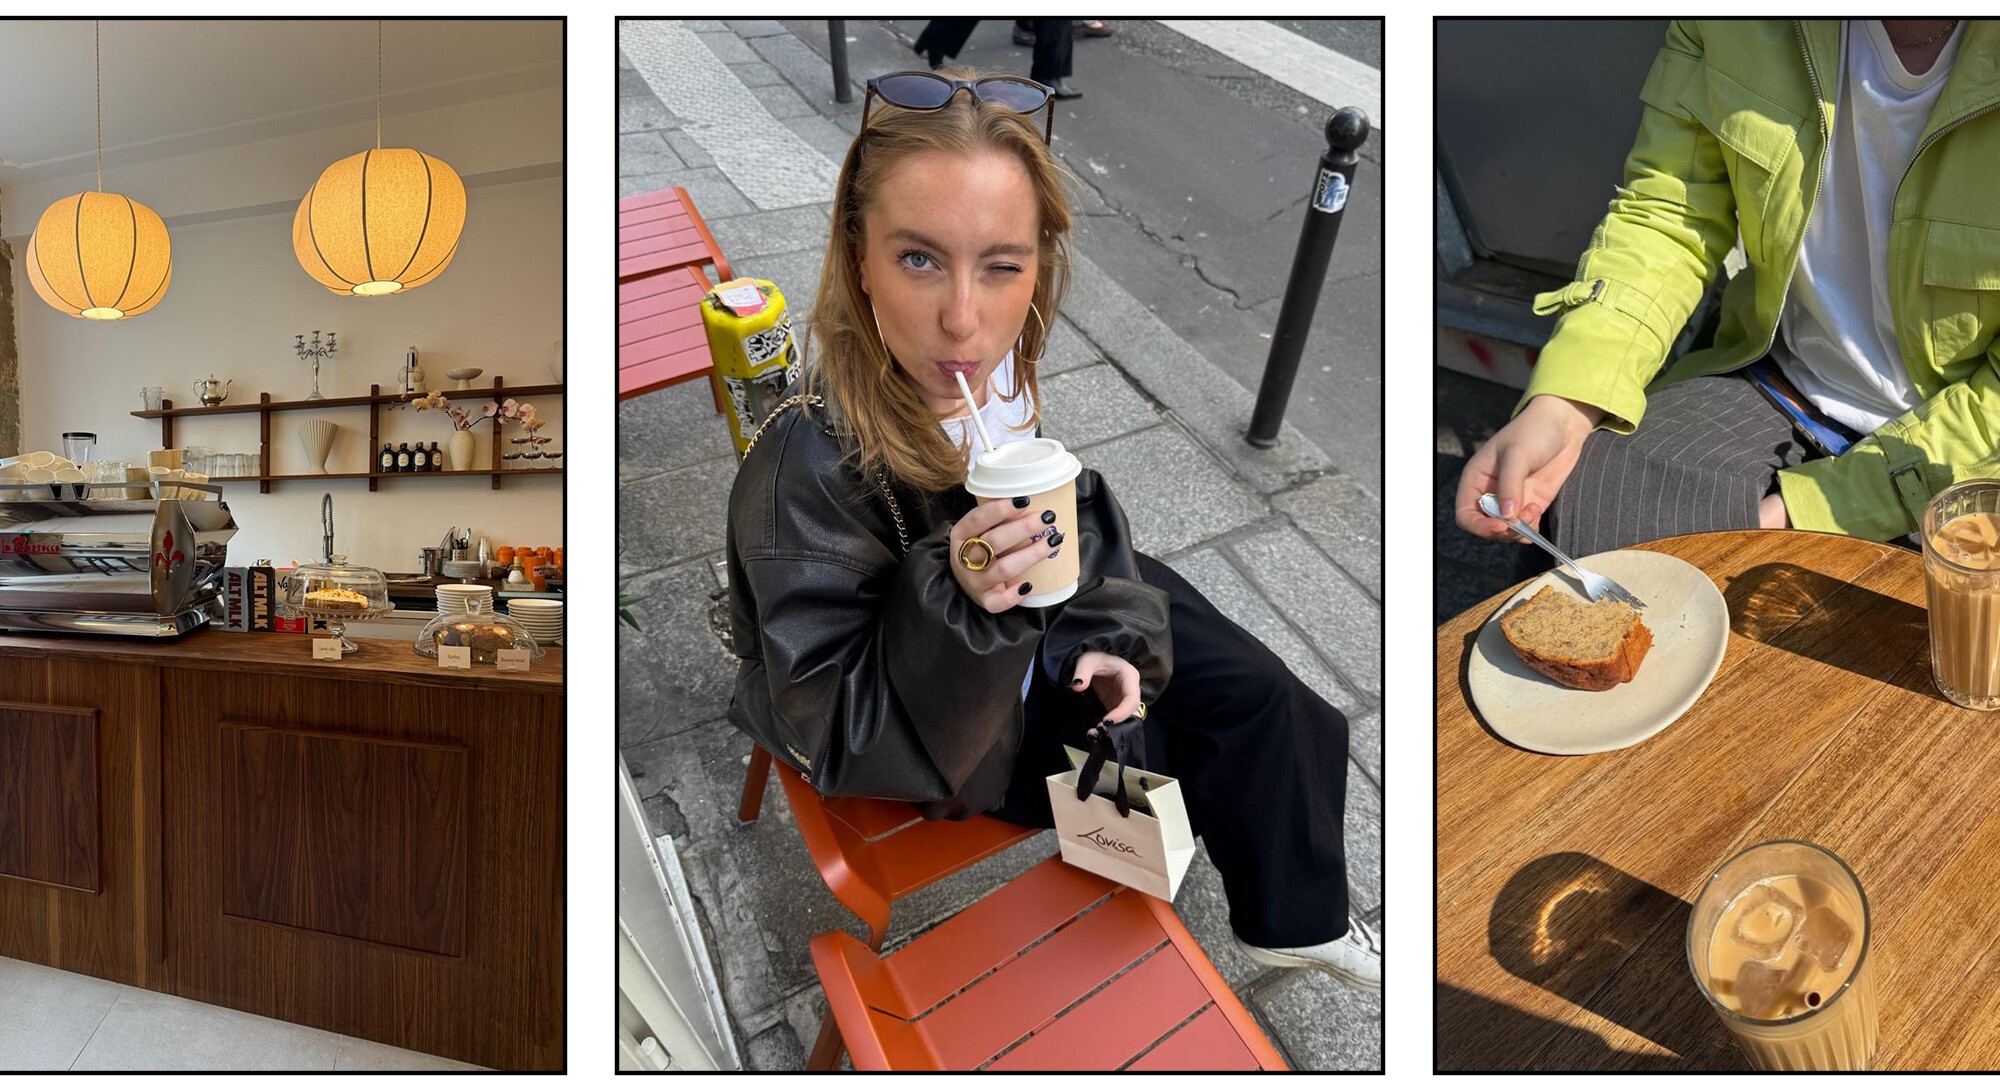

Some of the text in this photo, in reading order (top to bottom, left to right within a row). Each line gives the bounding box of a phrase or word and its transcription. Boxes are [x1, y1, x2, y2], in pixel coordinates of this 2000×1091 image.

[228, 571, 242, 629] ALTMLK
[253, 570, 268, 629] ALTMLK
[1076, 826, 1144, 859] Lovisa
